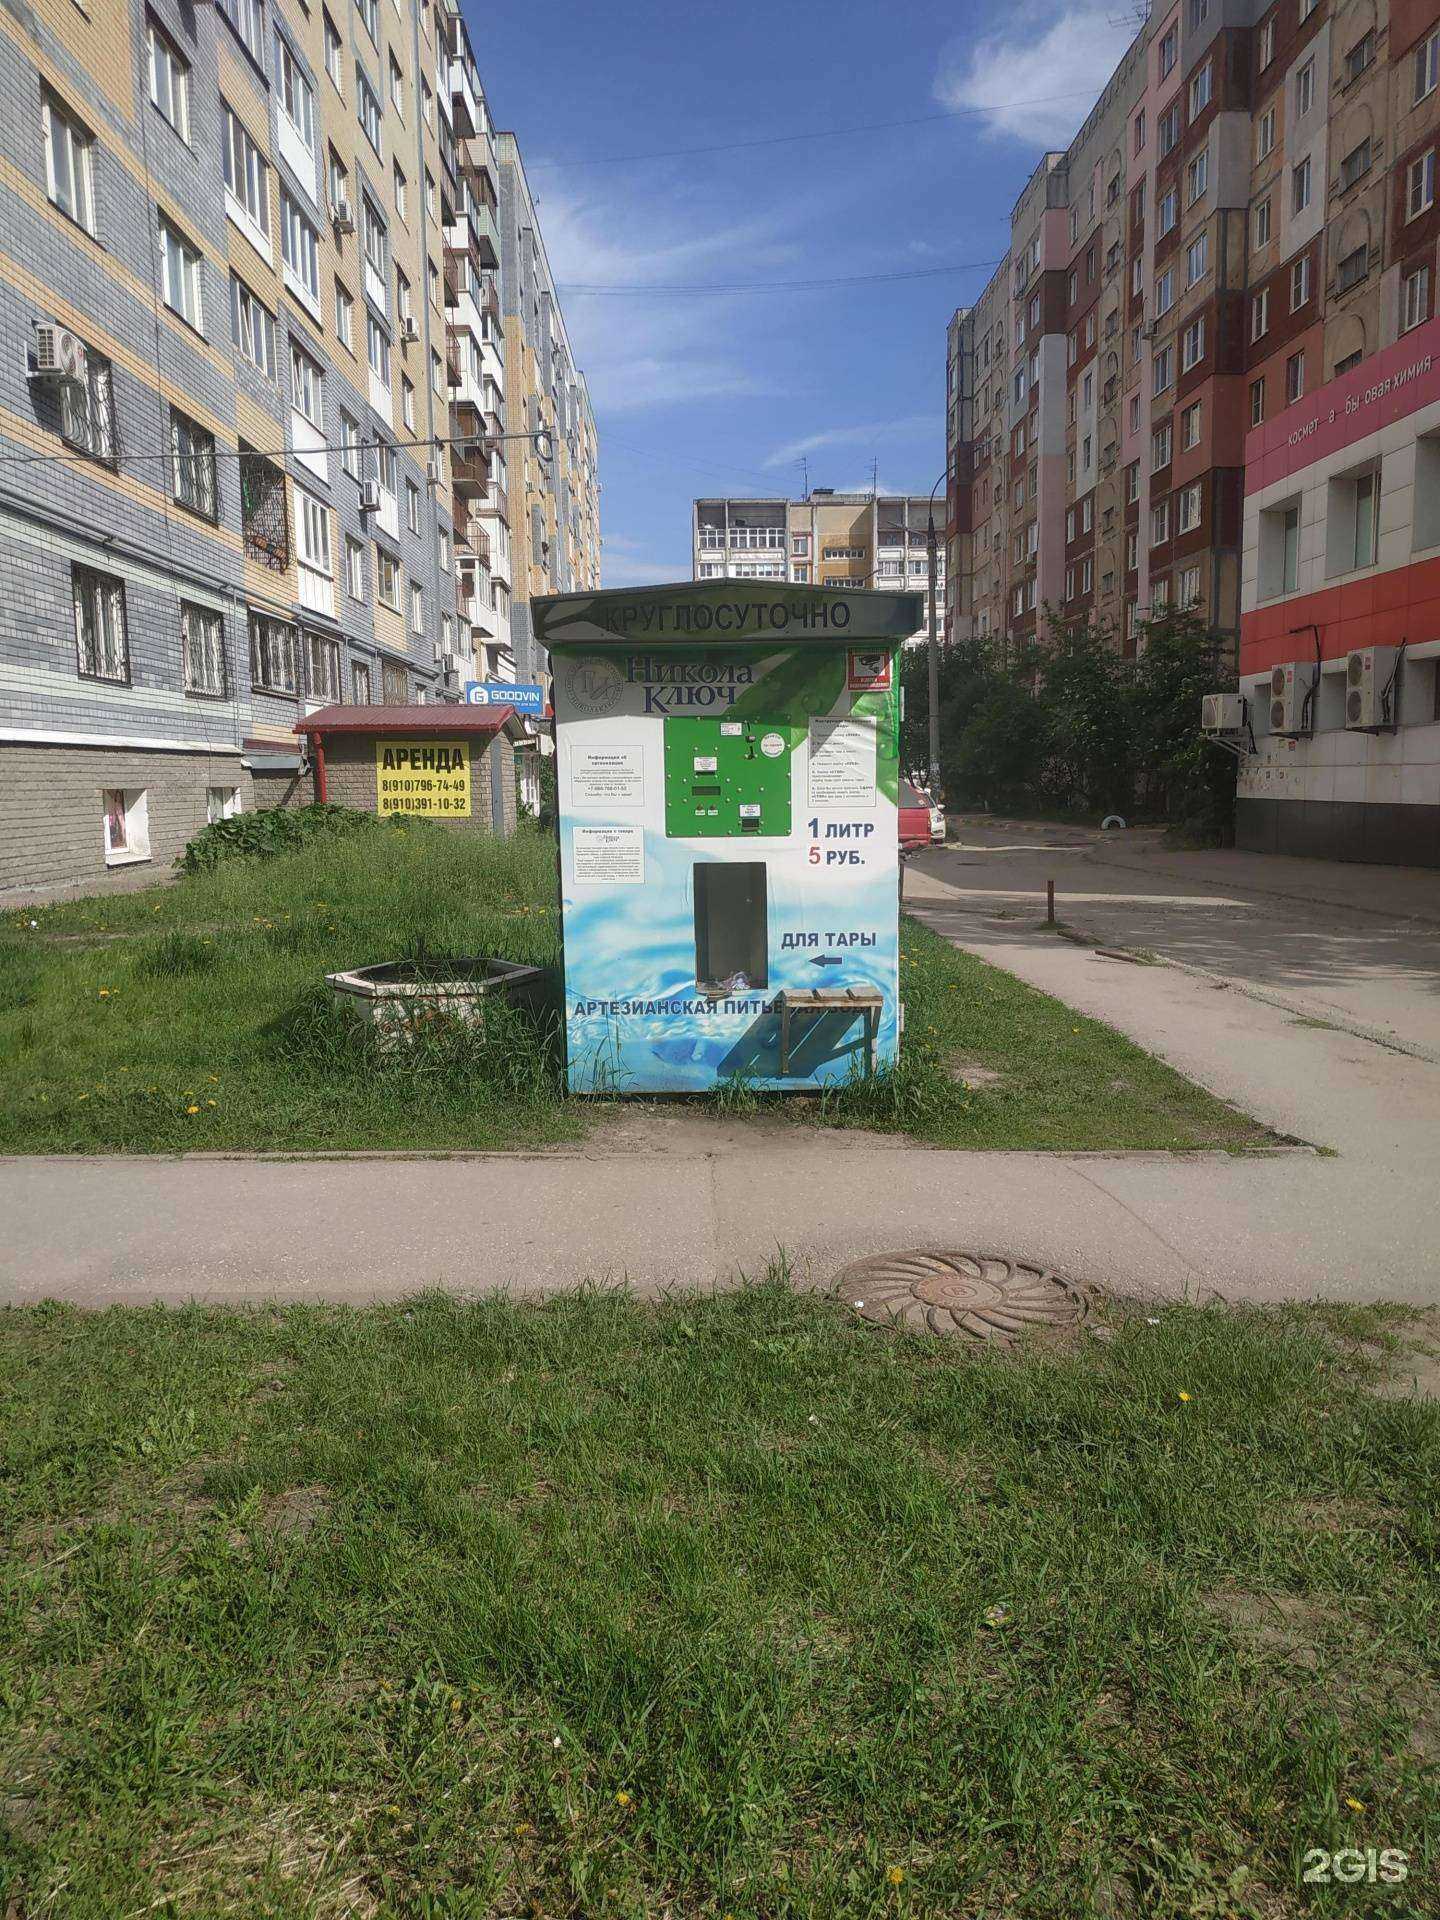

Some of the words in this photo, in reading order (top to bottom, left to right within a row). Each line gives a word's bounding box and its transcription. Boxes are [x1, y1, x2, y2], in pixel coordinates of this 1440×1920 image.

[1393, 354, 1432, 390] химия
[604, 600, 850, 632] КРУГЛОСУТОЧНО
[625, 656, 754, 684] Никола
[491, 690, 540, 702] GOODVIN
[643, 684, 737, 714] Ключ
[382, 748, 465, 774] АРЕНДА
[382, 779, 465, 792] 8(910)796-74-49
[382, 797, 466, 810] 8(910)391-10-32
[807, 817, 820, 839] 1
[824, 822, 875, 838] ЛИТР
[808, 846, 821, 865] 5
[826, 850, 866, 865] РУБ.
[781, 932, 819, 950] ДЛЯ
[825, 931, 877, 947] ТАРЫ
[574, 999, 718, 1016] АРТЕЗИАНСКАЯ
